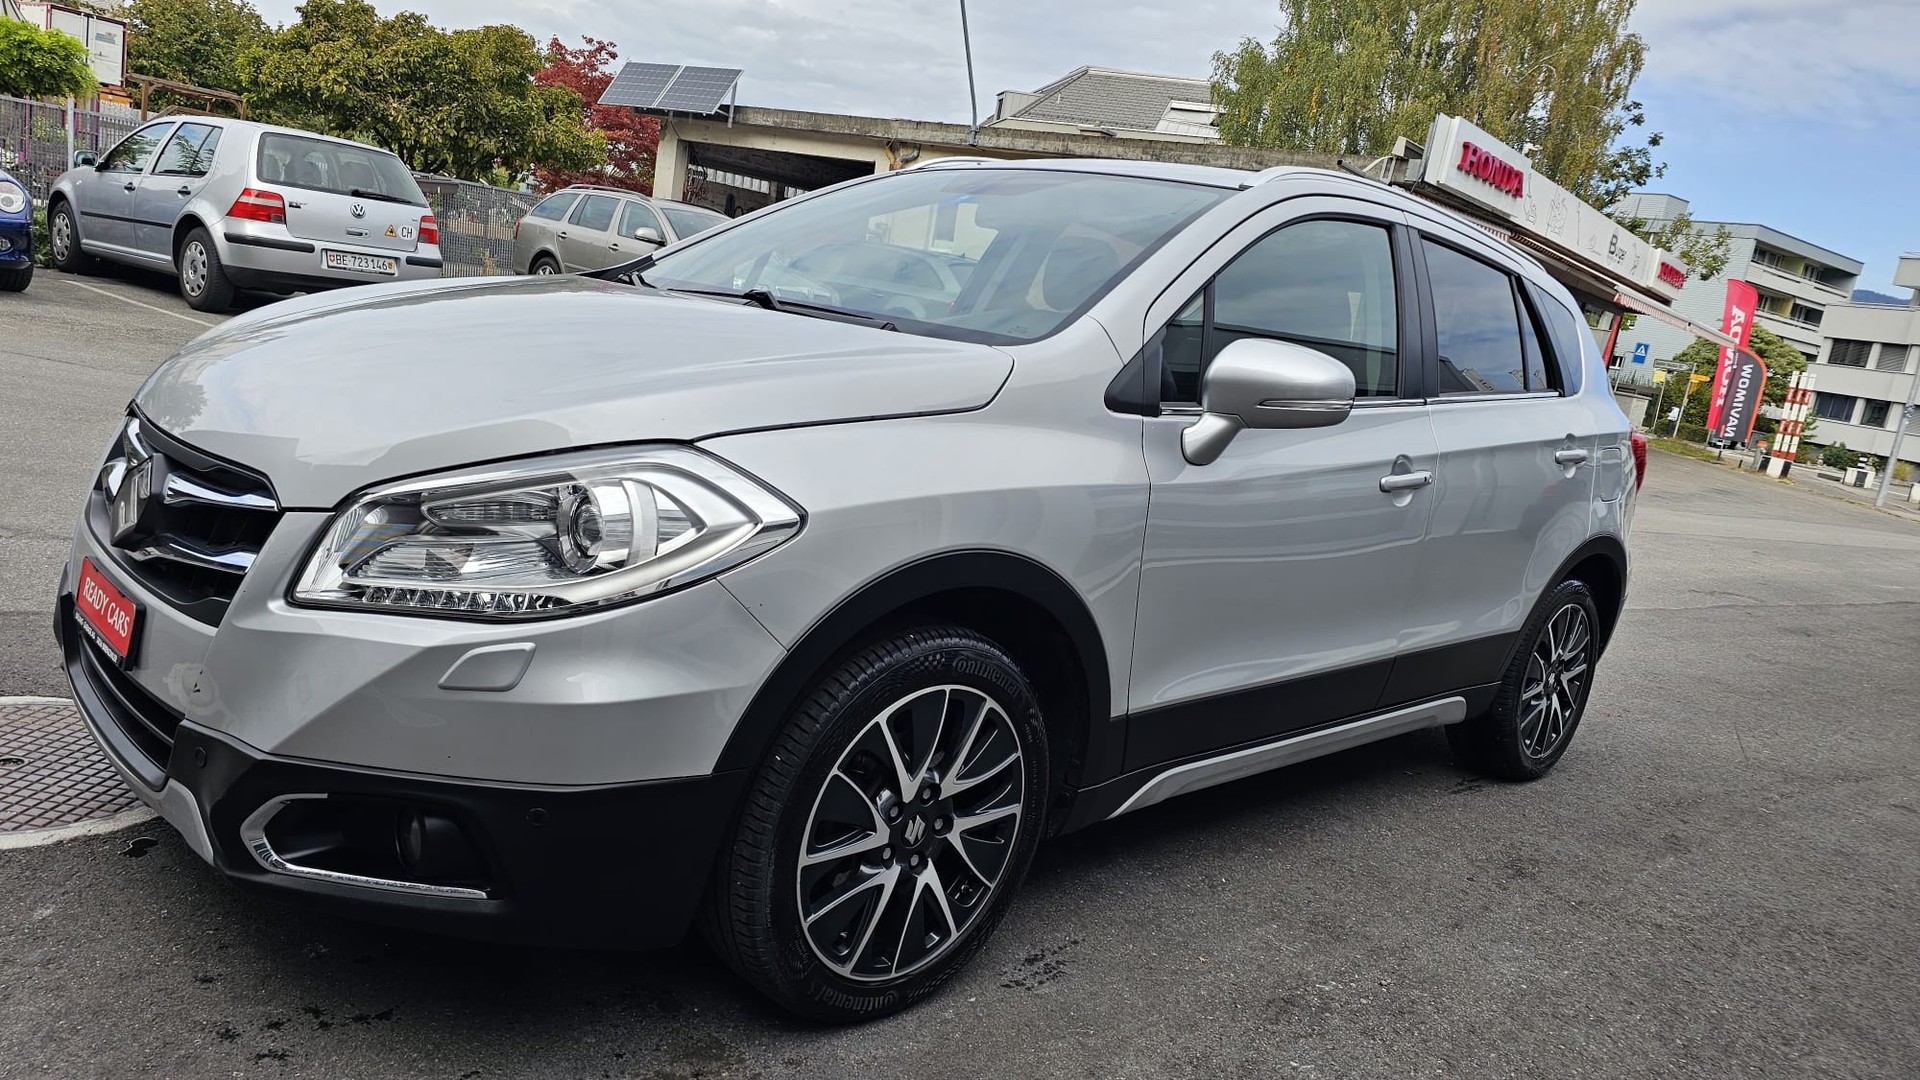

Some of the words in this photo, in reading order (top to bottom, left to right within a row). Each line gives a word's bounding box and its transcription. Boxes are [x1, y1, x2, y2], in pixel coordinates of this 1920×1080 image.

[1457, 141, 1524, 198] HONDA
[401, 226, 413, 239] CH
[335, 254, 348, 266] BE
[352, 255, 388, 271] 723146
[82, 576, 109, 616] READY
[106, 602, 131, 638] CARS
